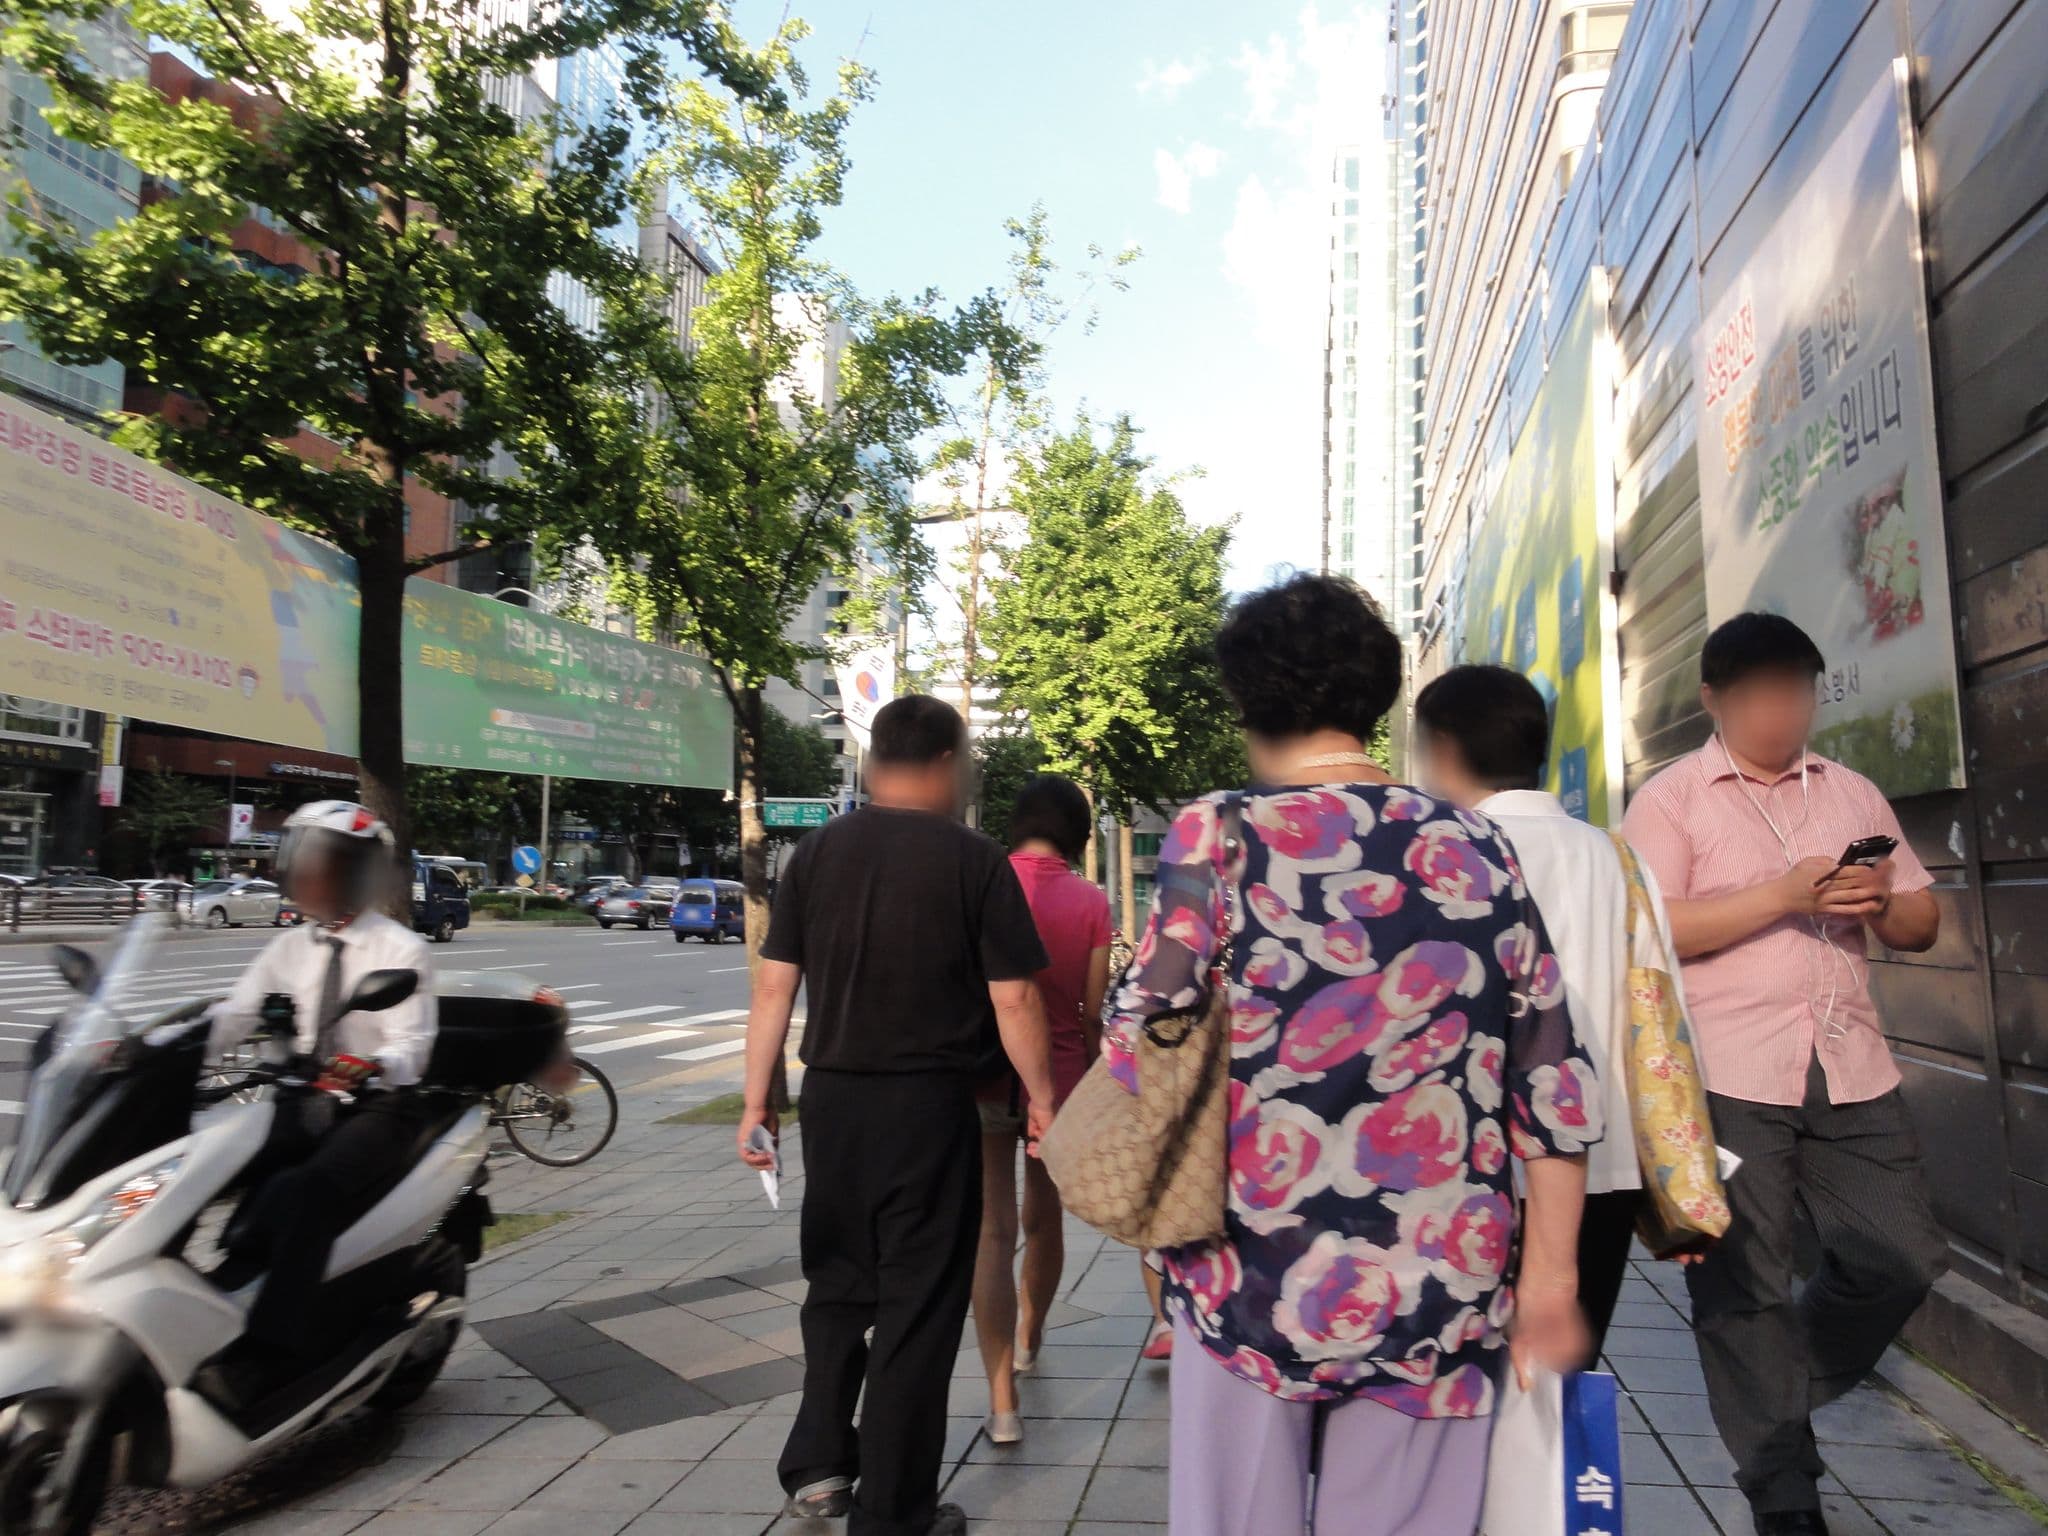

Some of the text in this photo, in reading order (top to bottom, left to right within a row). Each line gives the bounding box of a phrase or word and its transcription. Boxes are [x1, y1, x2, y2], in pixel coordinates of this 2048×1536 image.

[1704, 299, 1757, 408] 소방안전
[1722, 394, 1765, 479] 행복한
[1820, 284, 1859, 376] 위한
[1756, 348, 1903, 532] 소중한 약속입니다
[1820, 662, 1860, 704] 소방서
